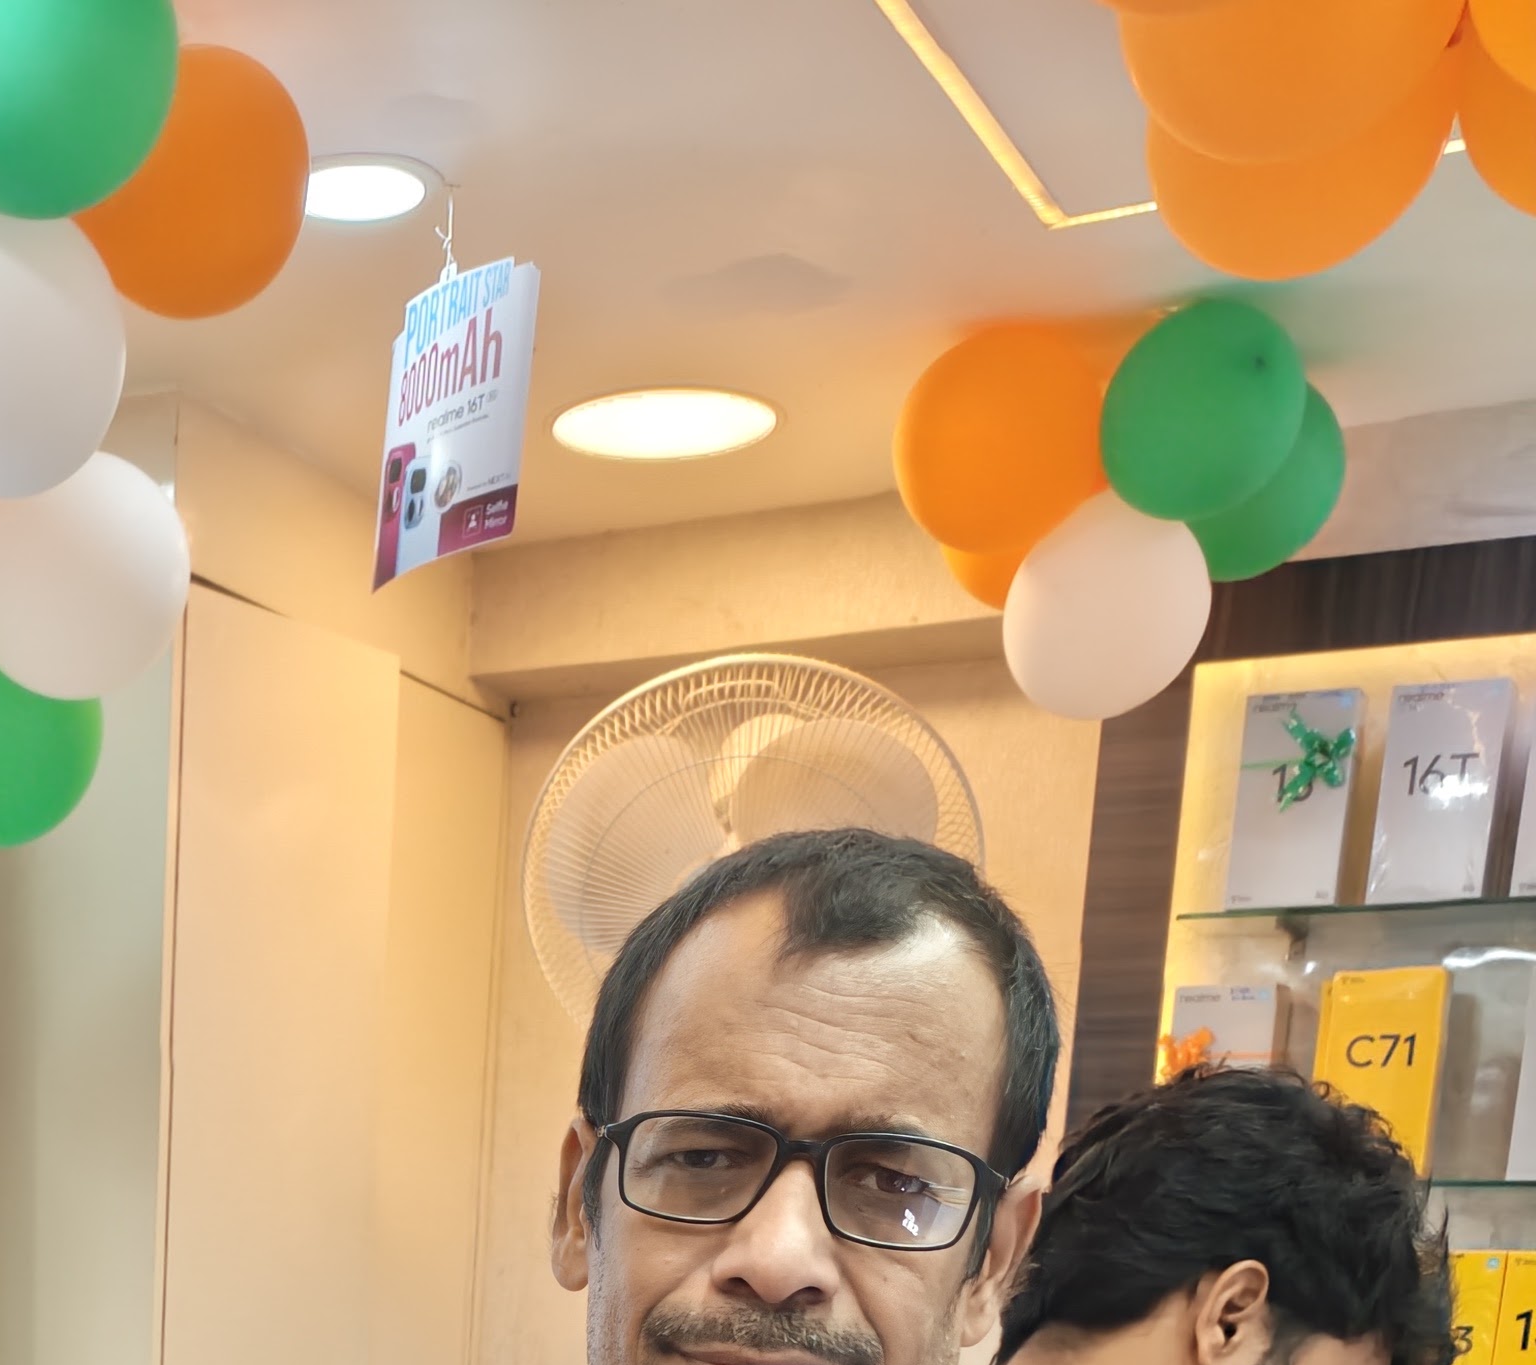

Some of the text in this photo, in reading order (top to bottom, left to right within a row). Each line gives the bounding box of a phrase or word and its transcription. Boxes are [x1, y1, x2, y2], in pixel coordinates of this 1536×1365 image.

[398, 306, 503, 427] 8000mAh
[404, 260, 511, 369] PORTRAIT STAR
[1345, 1033, 1417, 1068] C71
